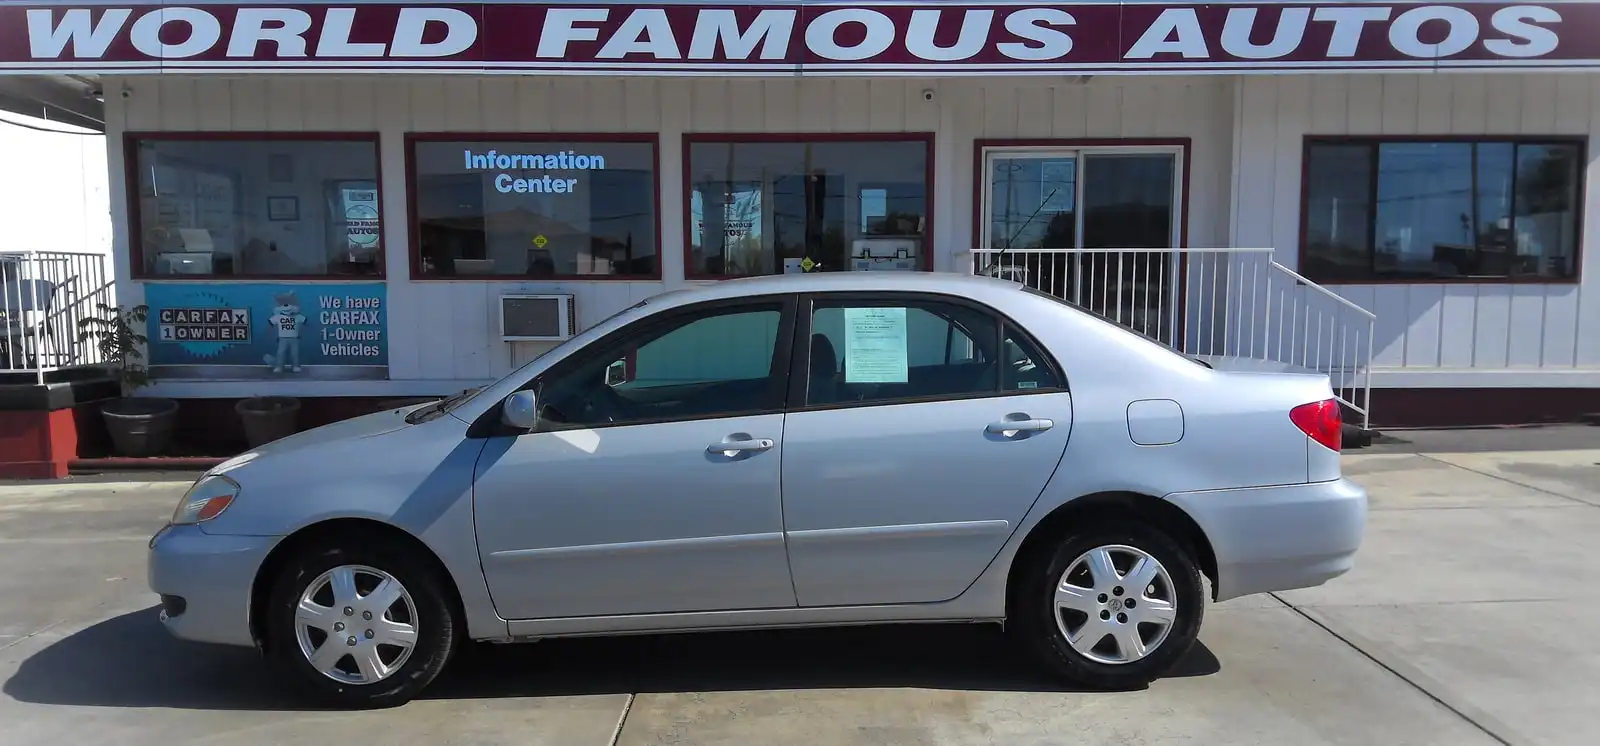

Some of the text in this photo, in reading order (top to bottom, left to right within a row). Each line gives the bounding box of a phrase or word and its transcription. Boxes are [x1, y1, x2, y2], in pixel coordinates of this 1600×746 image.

[26, 5, 1563, 61] WORLD FAMOUS AUTOS
[464, 150, 605, 170] Information
[494, 173, 578, 193] Center
[319, 295, 380, 308] We have
[161, 309, 246, 324] CARFAX
[319, 310, 380, 325] CARFAX
[163, 327, 246, 340] 1 OWNER
[320, 327, 381, 341] 1-Owner
[320, 343, 380, 356] Vehicles
